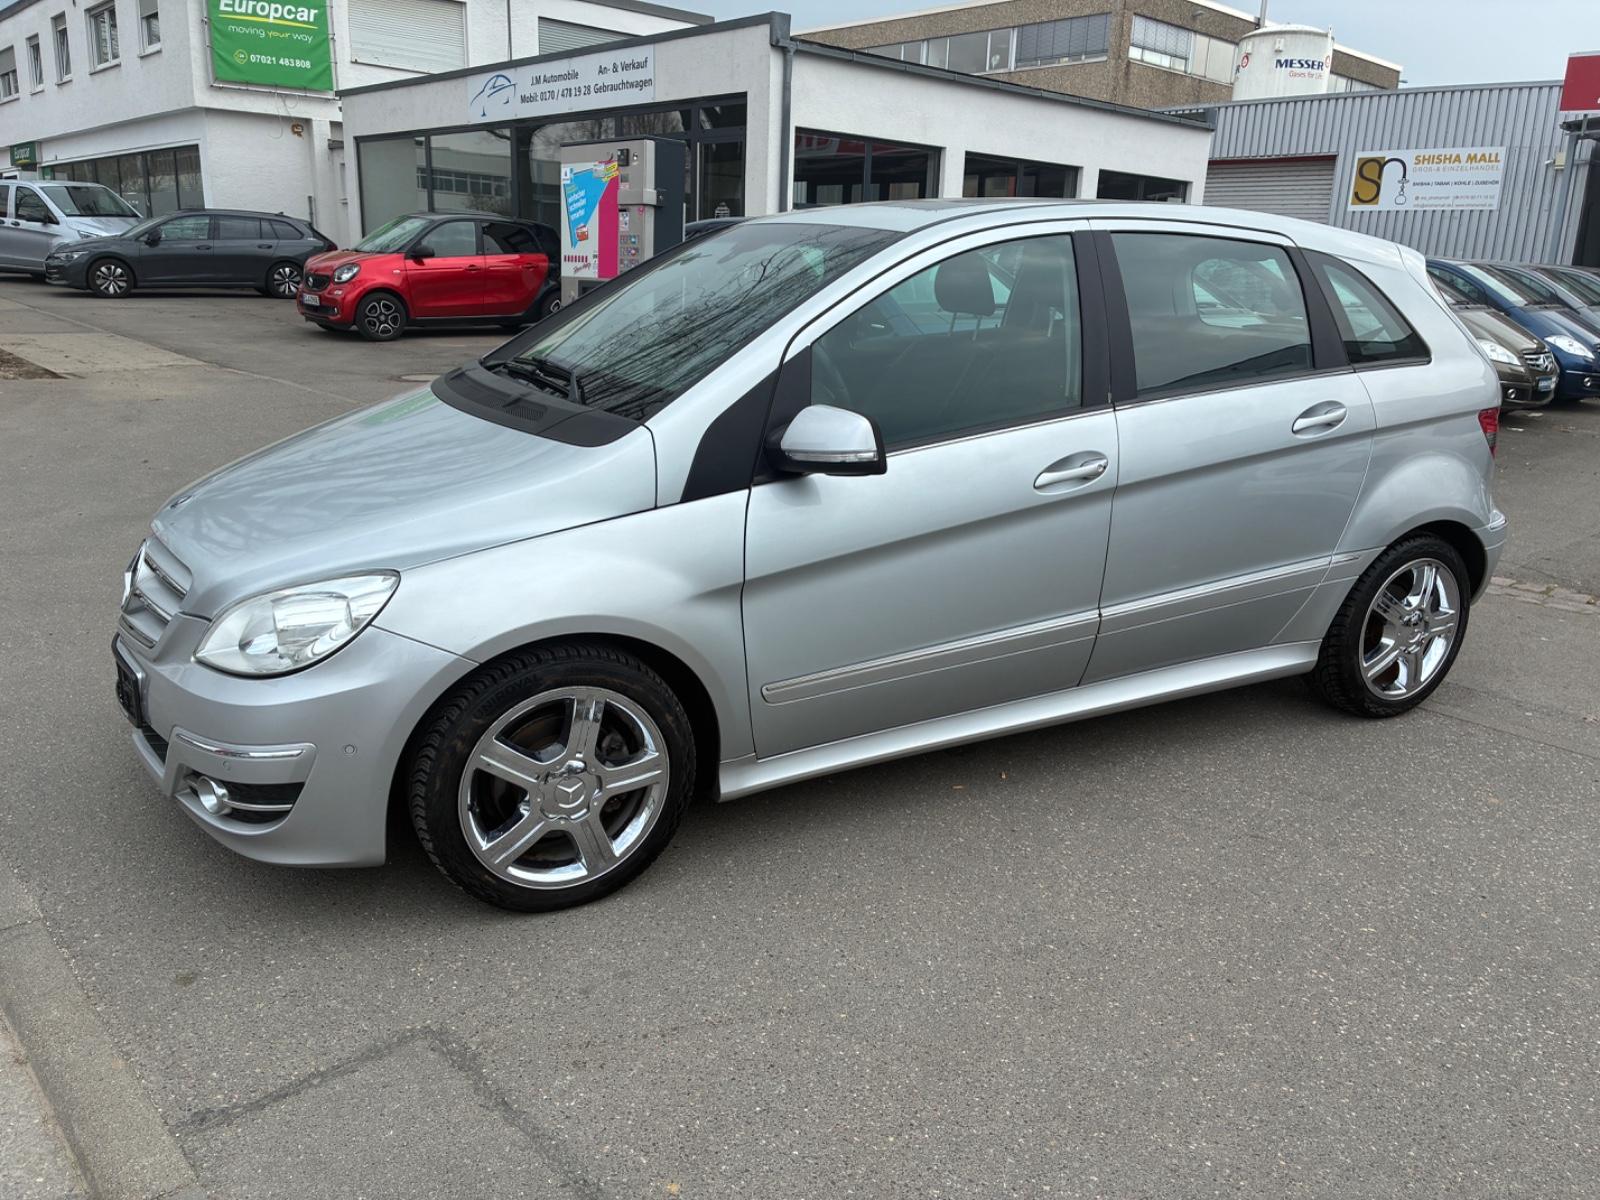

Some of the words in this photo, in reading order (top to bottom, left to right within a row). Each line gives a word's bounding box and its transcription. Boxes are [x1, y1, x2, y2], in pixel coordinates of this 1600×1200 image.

[219, 0, 318, 23] Europcar
[228, 25, 265, 38] moving
[292, 34, 313, 43] way
[250, 54, 276, 65] 07021
[598, 65, 610, 75] An-
[612, 62, 619, 73] &
[620, 57, 648, 72] Verkauf
[1275, 59, 1324, 71] MESSER
[542, 69, 579, 83] Automobile
[593, 78, 653, 93] Gebrauchtwagen
[520, 93, 538, 104] Mobil:
[540, 91, 555, 102] 0170
[574, 86, 581, 96] 19
[583, 85, 591, 95] 28
[1414, 153, 1461, 165] SHISHA
[1465, 152, 1500, 163] MALL
